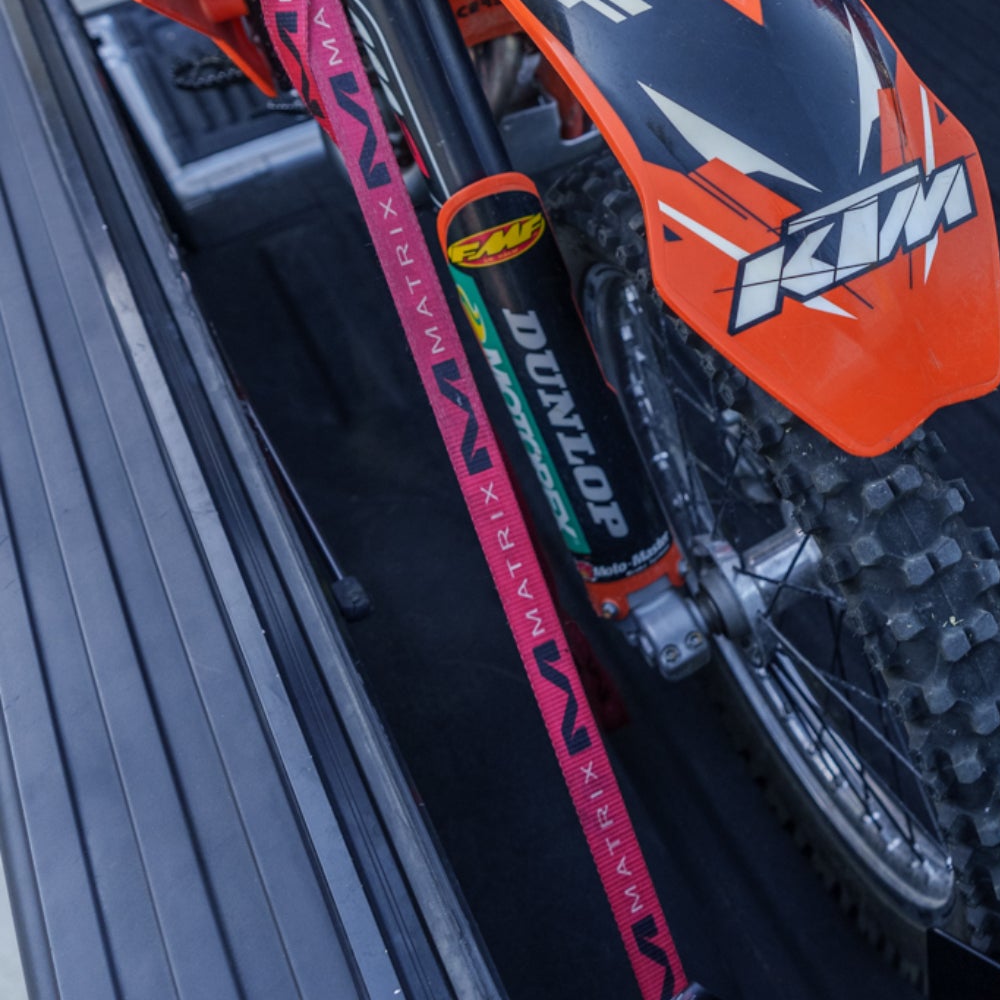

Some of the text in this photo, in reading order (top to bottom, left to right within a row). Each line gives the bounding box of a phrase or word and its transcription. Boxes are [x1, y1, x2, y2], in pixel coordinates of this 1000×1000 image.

[379, 196, 446, 355] MATRIX
[450, 213, 543, 264] FMF
[728, 156, 977, 335] KTM
[501, 308, 630, 539] DUNLOP
[480, 480, 545, 637] MATRIX
[580, 760, 644, 914] MATRIX
